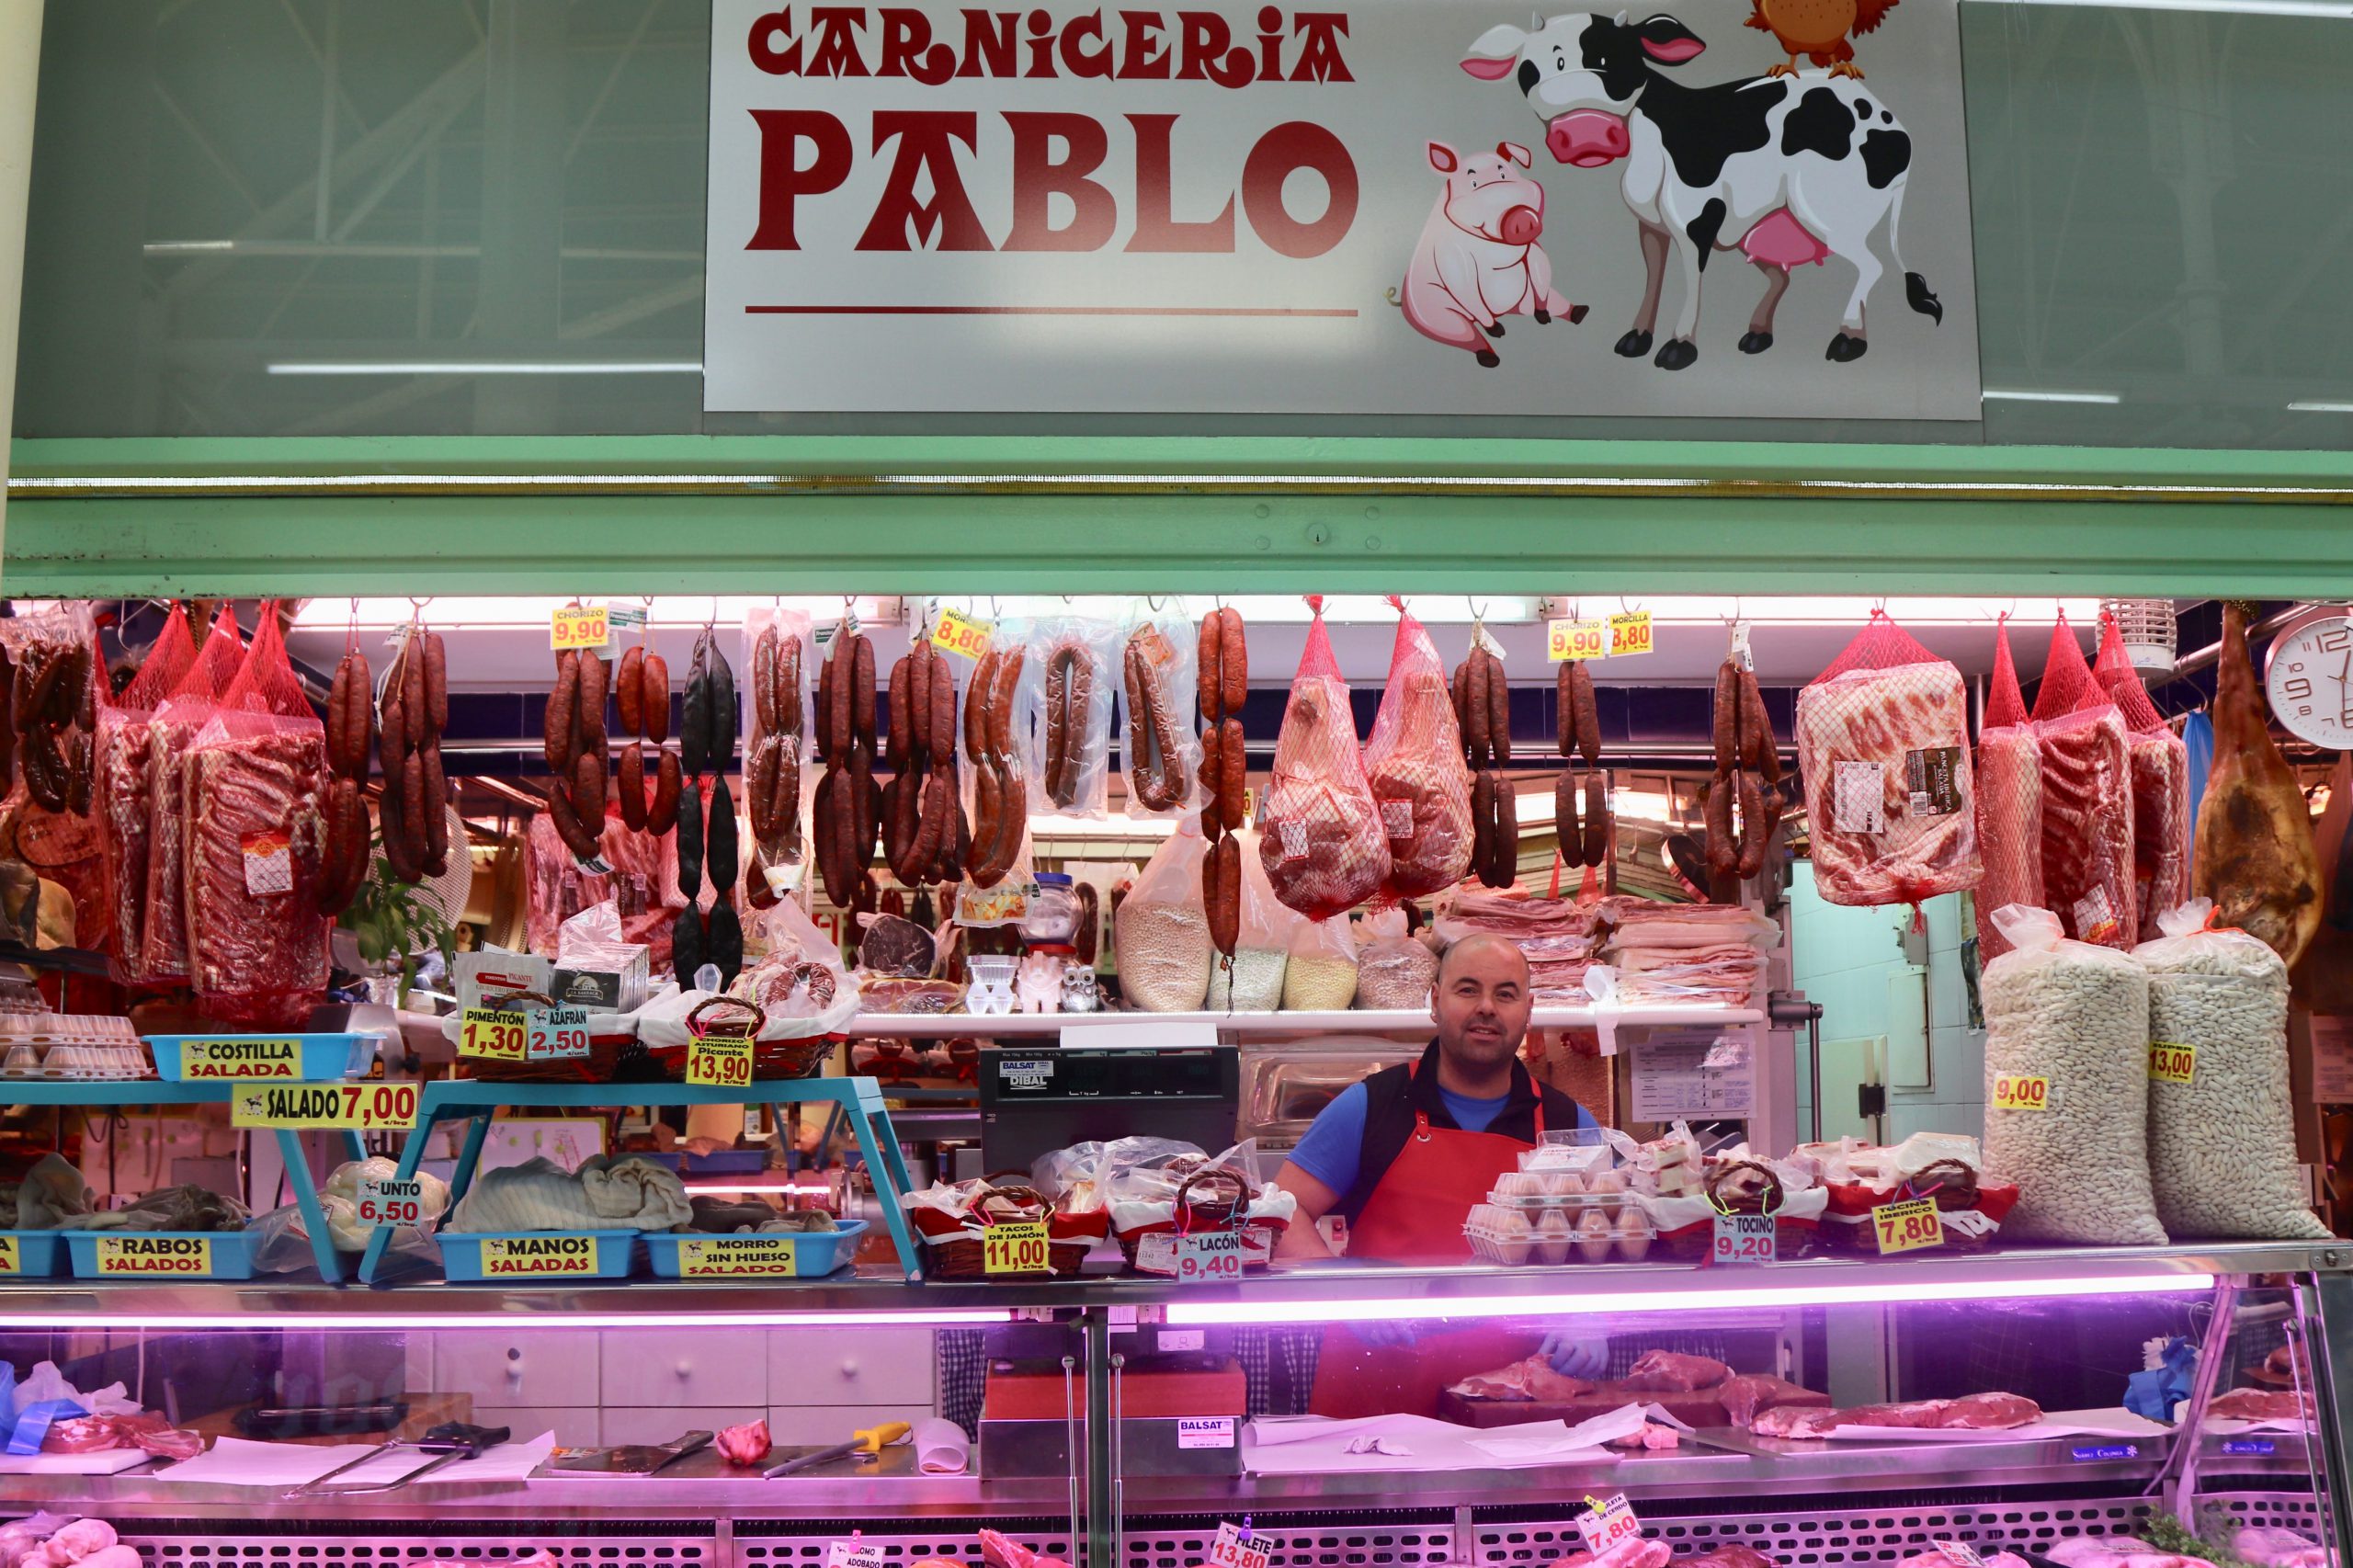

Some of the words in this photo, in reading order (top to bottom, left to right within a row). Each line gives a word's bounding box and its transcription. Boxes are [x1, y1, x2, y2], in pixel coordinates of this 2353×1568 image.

[744, 108, 1359, 259] PABLO
[557, 609, 604, 619] CHORIZO
[1612, 614, 1648, 625] MORCILLA
[555, 619, 606, 643] 9,90
[1554, 621, 1600, 631] CHORIZO
[937, 620, 986, 654] 8,80
[1552, 631, 1601, 655] 9,90
[2288, 662, 2304, 673] 10
[2284, 678, 2312, 700] 9
[2299, 705, 2312, 716] 8
[508, 972, 532, 983] PICANTE
[466, 1010, 525, 1026] PIMENTÓN
[463, 1023, 524, 1054] 1,30
[531, 1029, 586, 1054] 2,50
[2153, 1042, 2192, 1051] SUPER
[209, 1043, 294, 1060] COSTILLA
[699, 1047, 745, 1056] Picante
[190, 1062, 293, 1077] SALADA
[690, 1055, 750, 1084] 13,90
[1003, 1062, 1036, 1070] BALSAT
[2149, 1050, 2192, 1077] 13,00
[1010, 1075, 1048, 1085] DIBAL
[1997, 1079, 2045, 1105] 9,00
[267, 1088, 340, 1119] SALADO
[342, 1086, 415, 1126] 7,00
[381, 1182, 421, 1197] UNTO
[359, 1199, 419, 1224] 6,50
[1879, 1199, 1930, 1213] TOCINO
[1880, 1206, 1932, 1220] IBERICO
[1736, 1217, 1774, 1233] TOCINO
[1879, 1213, 1938, 1246] 7,80
[1006, 1232, 1045, 1240] JAMÓN
[1199, 1233, 1240, 1251] LACÓN
[122, 1238, 203, 1256] RABOS
[507, 1238, 590, 1256] MANOS
[716, 1239, 780, 1250] MORRO
[1717, 1236, 1773, 1260] 9,20
[706, 1254, 731, 1263] SIN
[735, 1252, 791, 1263] HUESO
[987, 1239, 1045, 1270] 11,00
[106, 1257, 202, 1272] SALADOS
[490, 1257, 590, 1273] SALADAS
[688, 1264, 787, 1274] SALADO
[1181, 1255, 1239, 1278] 9,40
[1181, 1421, 1222, 1430] BALSAT
[1598, 1511, 1608, 1520] DE
[1608, 1501, 1628, 1516] CERDO
[1588, 1516, 1636, 1549] 7,80
[847, 1558, 880, 1568] ADOBADO
[1215, 1542, 1266, 1568] 13,80
